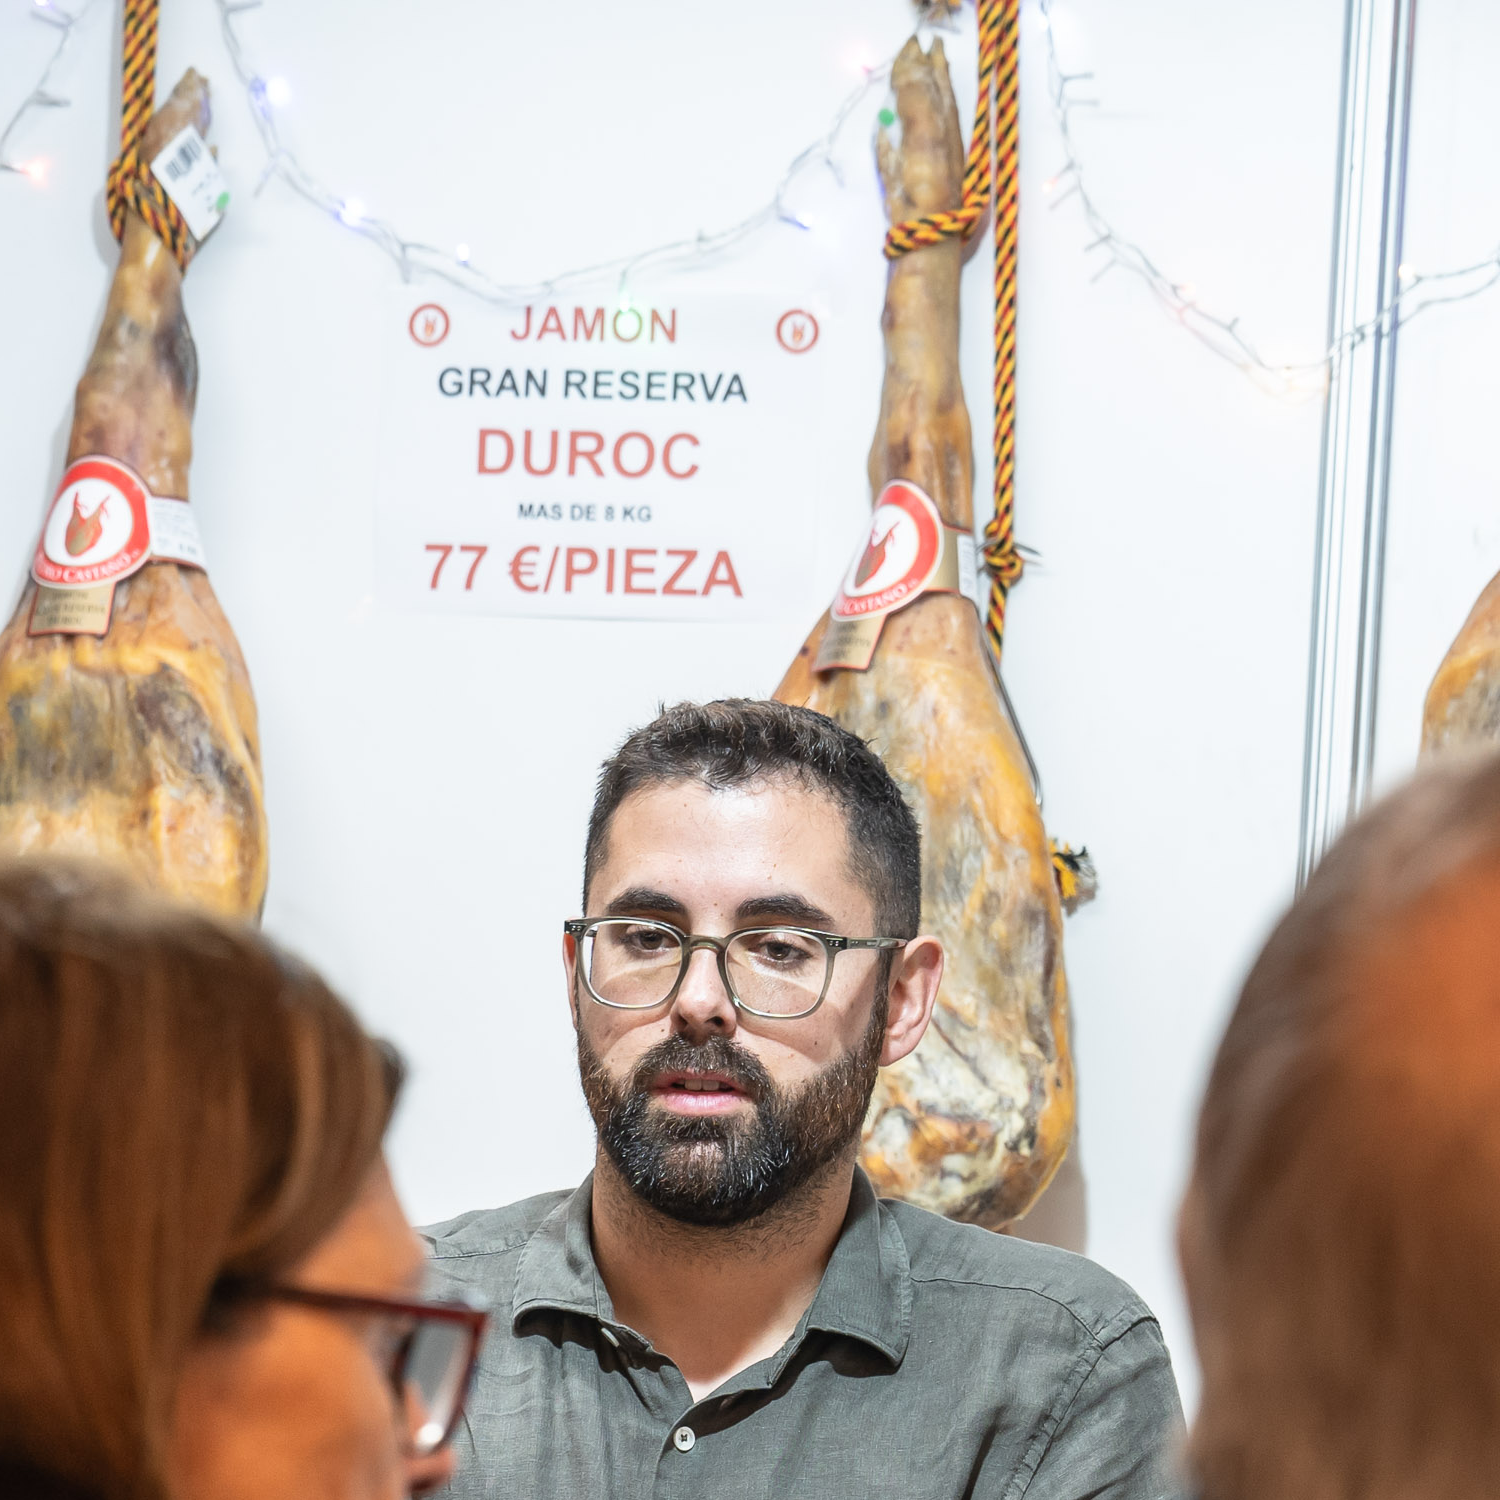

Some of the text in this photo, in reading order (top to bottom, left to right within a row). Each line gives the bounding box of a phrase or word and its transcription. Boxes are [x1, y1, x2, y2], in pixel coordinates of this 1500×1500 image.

[439, 368, 747, 402] GRAN RESERVA
[478, 429, 699, 479] DUROC
[519, 504, 651, 521] MAS DE 8 KG
[425, 544, 742, 597] 77 €/PIEZA
